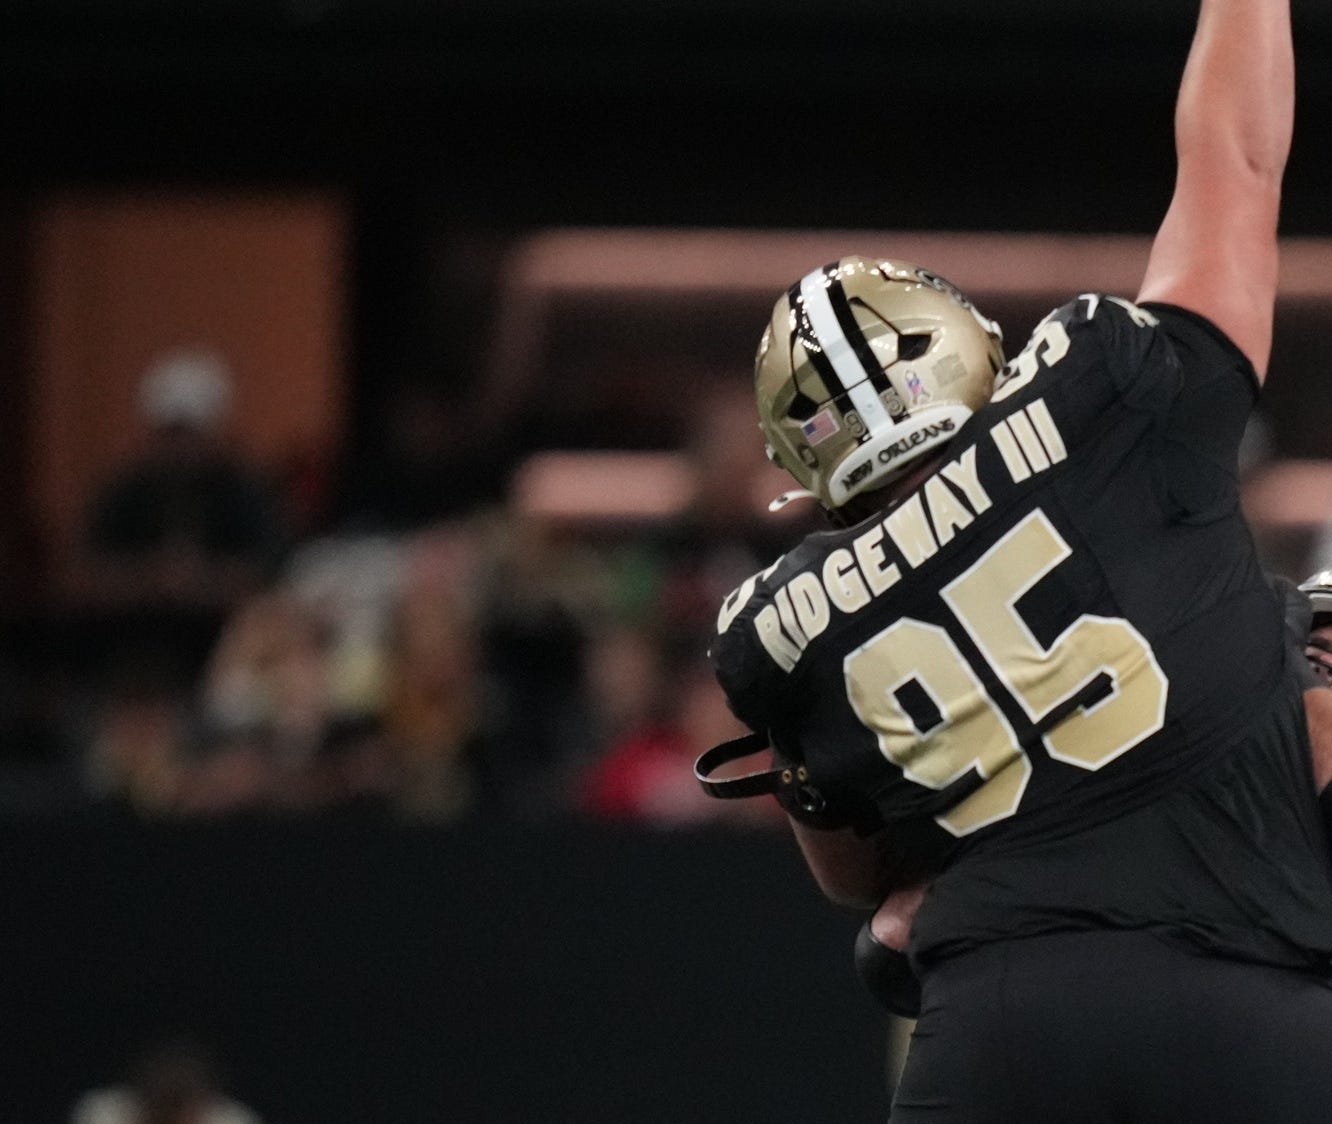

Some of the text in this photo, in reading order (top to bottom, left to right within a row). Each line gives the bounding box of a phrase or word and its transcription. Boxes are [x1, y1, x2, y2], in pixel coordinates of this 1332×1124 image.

[754, 444, 992, 674] RIDGEWAY
[990, 398, 1068, 484] III
[842, 417, 955, 491] NEW ORLEANS
[843, 507, 1169, 838] 95
